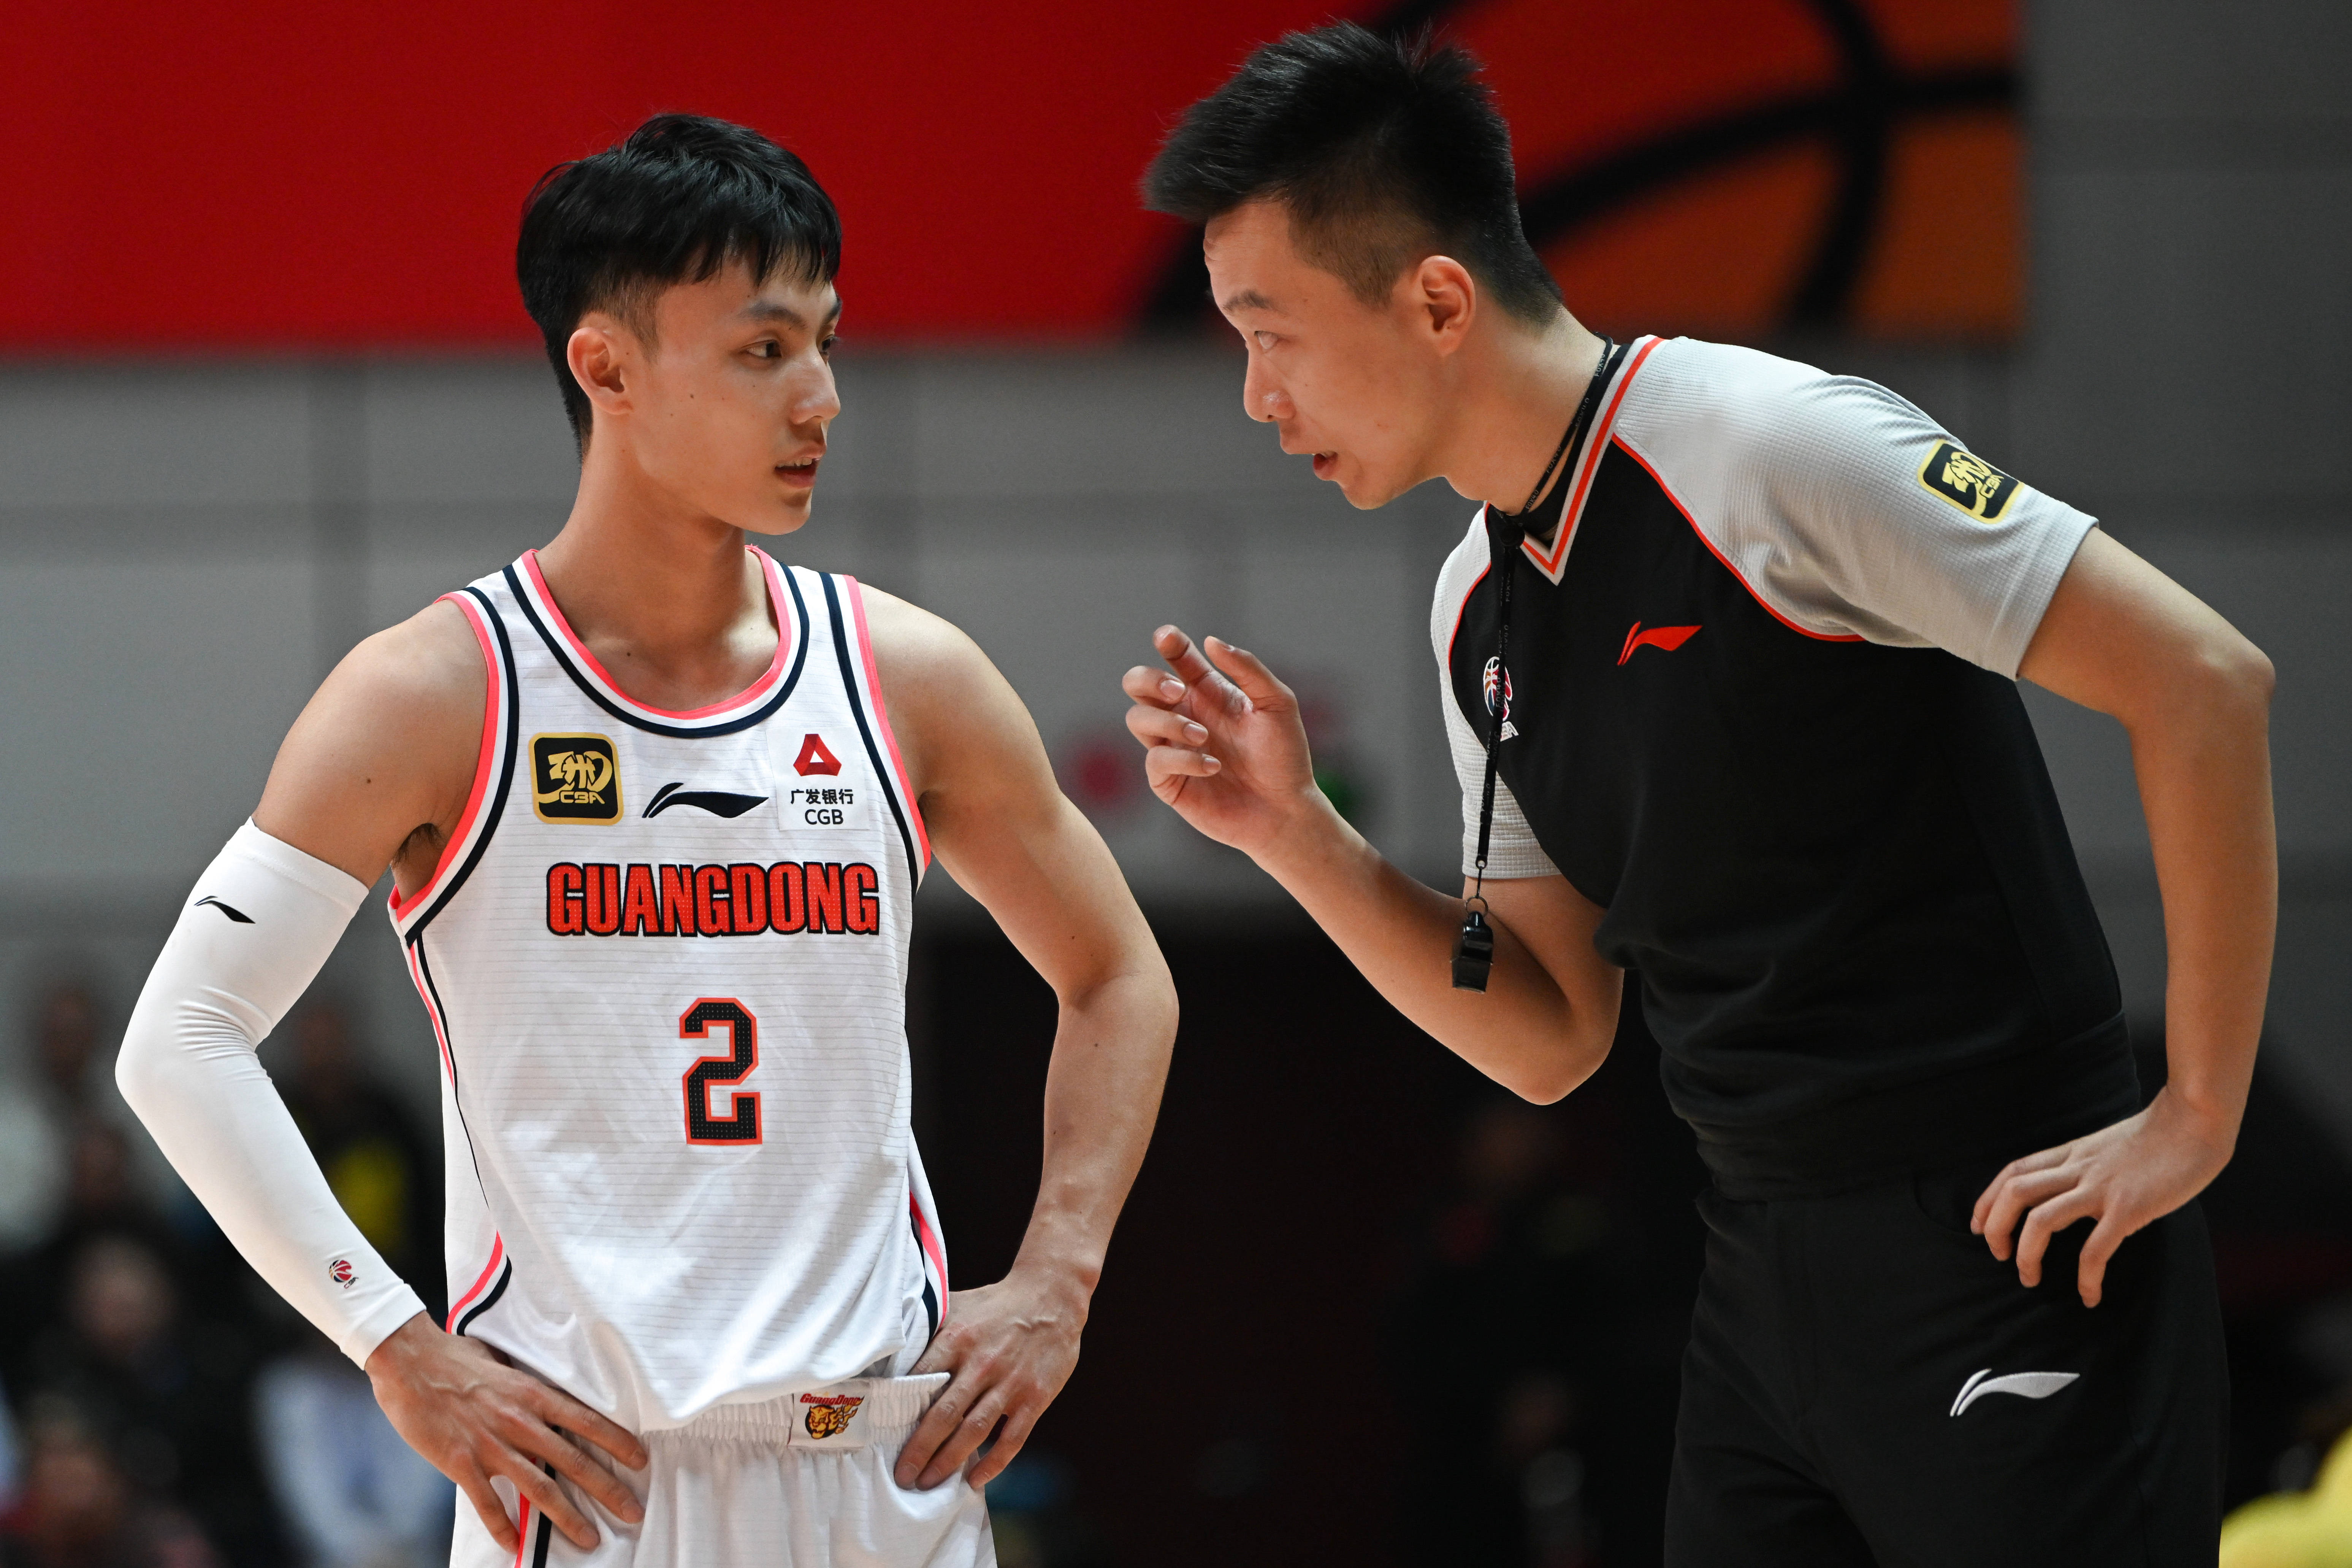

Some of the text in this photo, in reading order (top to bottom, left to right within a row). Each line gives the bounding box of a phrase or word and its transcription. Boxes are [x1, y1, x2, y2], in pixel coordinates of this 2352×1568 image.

[1980, 474, 2005, 499] CBA
[1525, 489, 1539, 509] FOX40
[1500, 721, 1520, 742] BA
[560, 791, 605, 804] CBA
[791, 789, 854, 805] 广发银行
[805, 809, 844, 825] CGB
[546, 861, 880, 937] GUANGDONG
[679, 997, 762, 1146] 2
